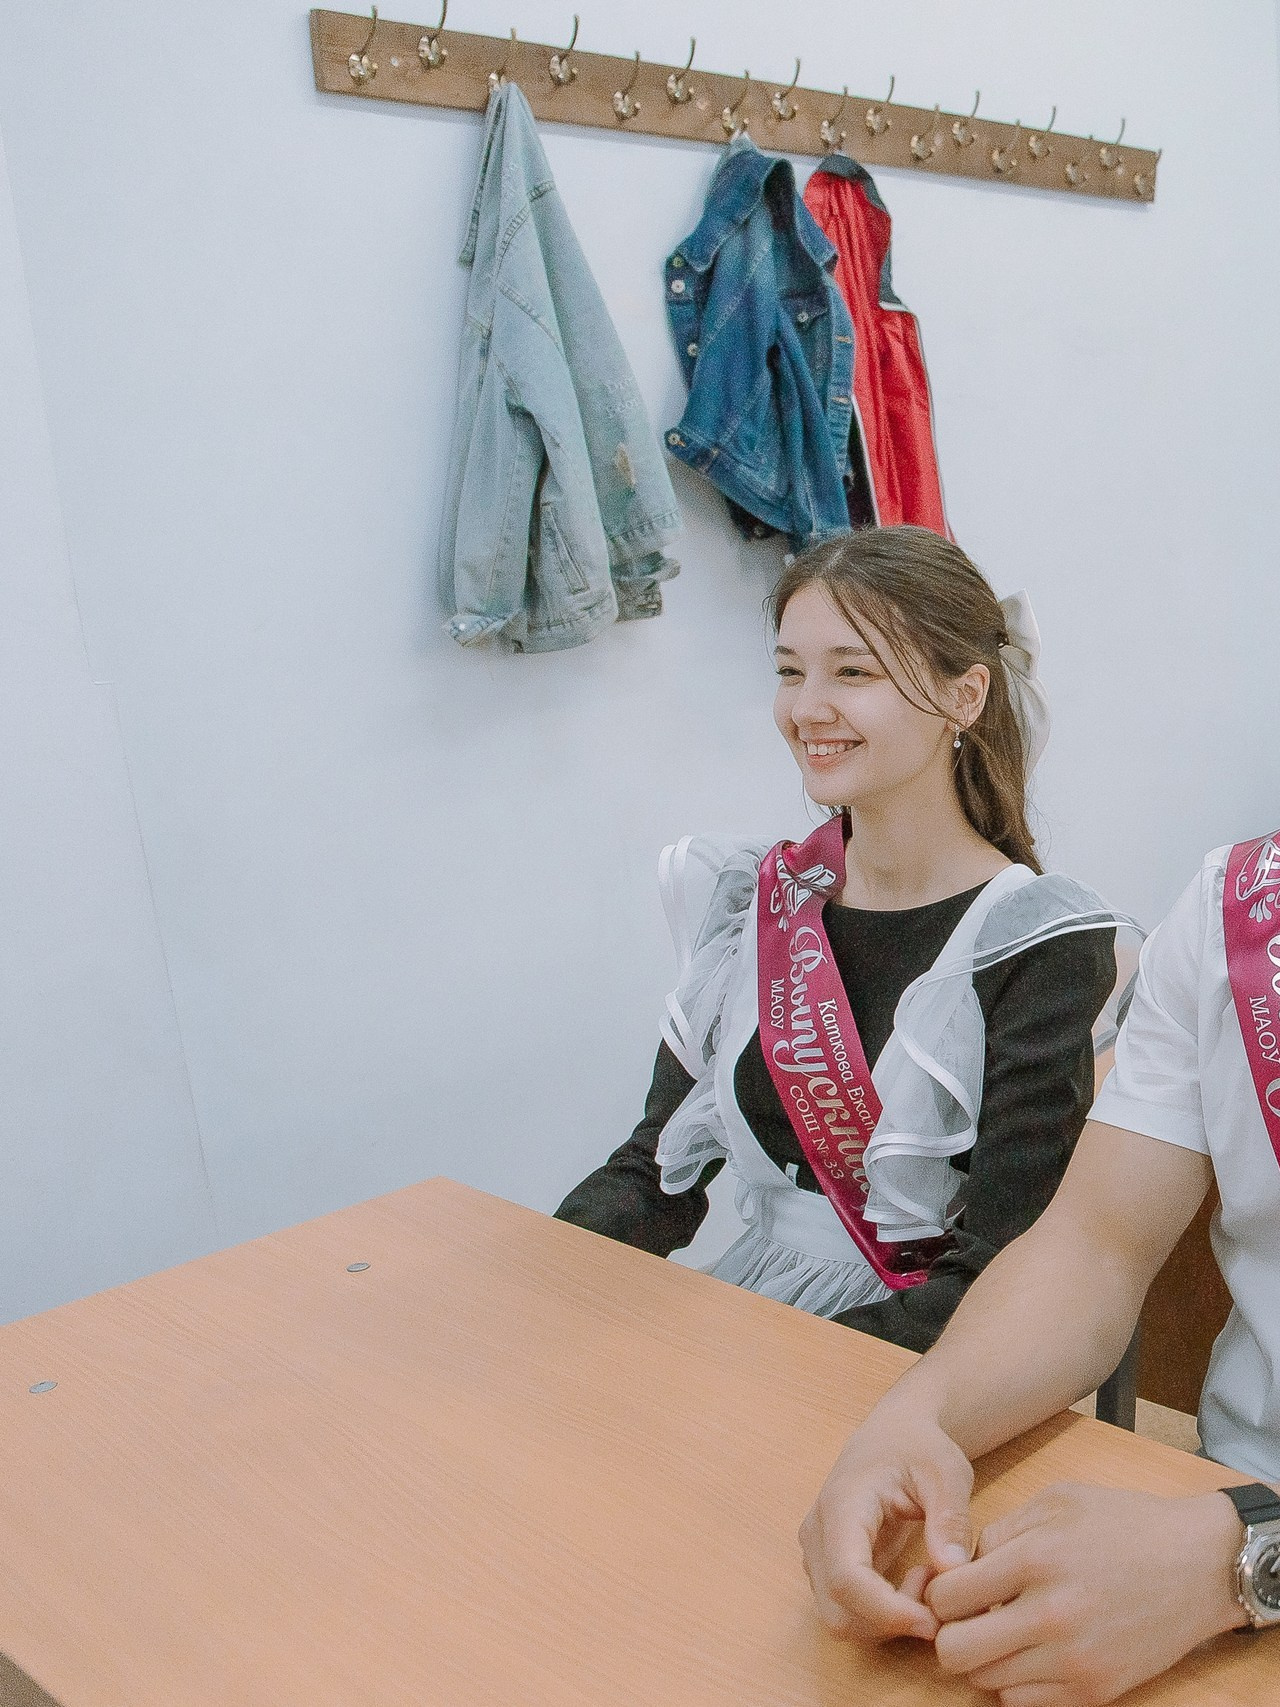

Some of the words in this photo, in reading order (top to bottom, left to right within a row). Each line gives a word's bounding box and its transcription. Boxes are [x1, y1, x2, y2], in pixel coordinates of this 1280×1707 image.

[770, 977, 785, 1030] МАОУ
[789, 1085, 820, 1133] СОШ
[772, 926, 871, 1197] Выпускни
[817, 997, 855, 1083] Каткова
